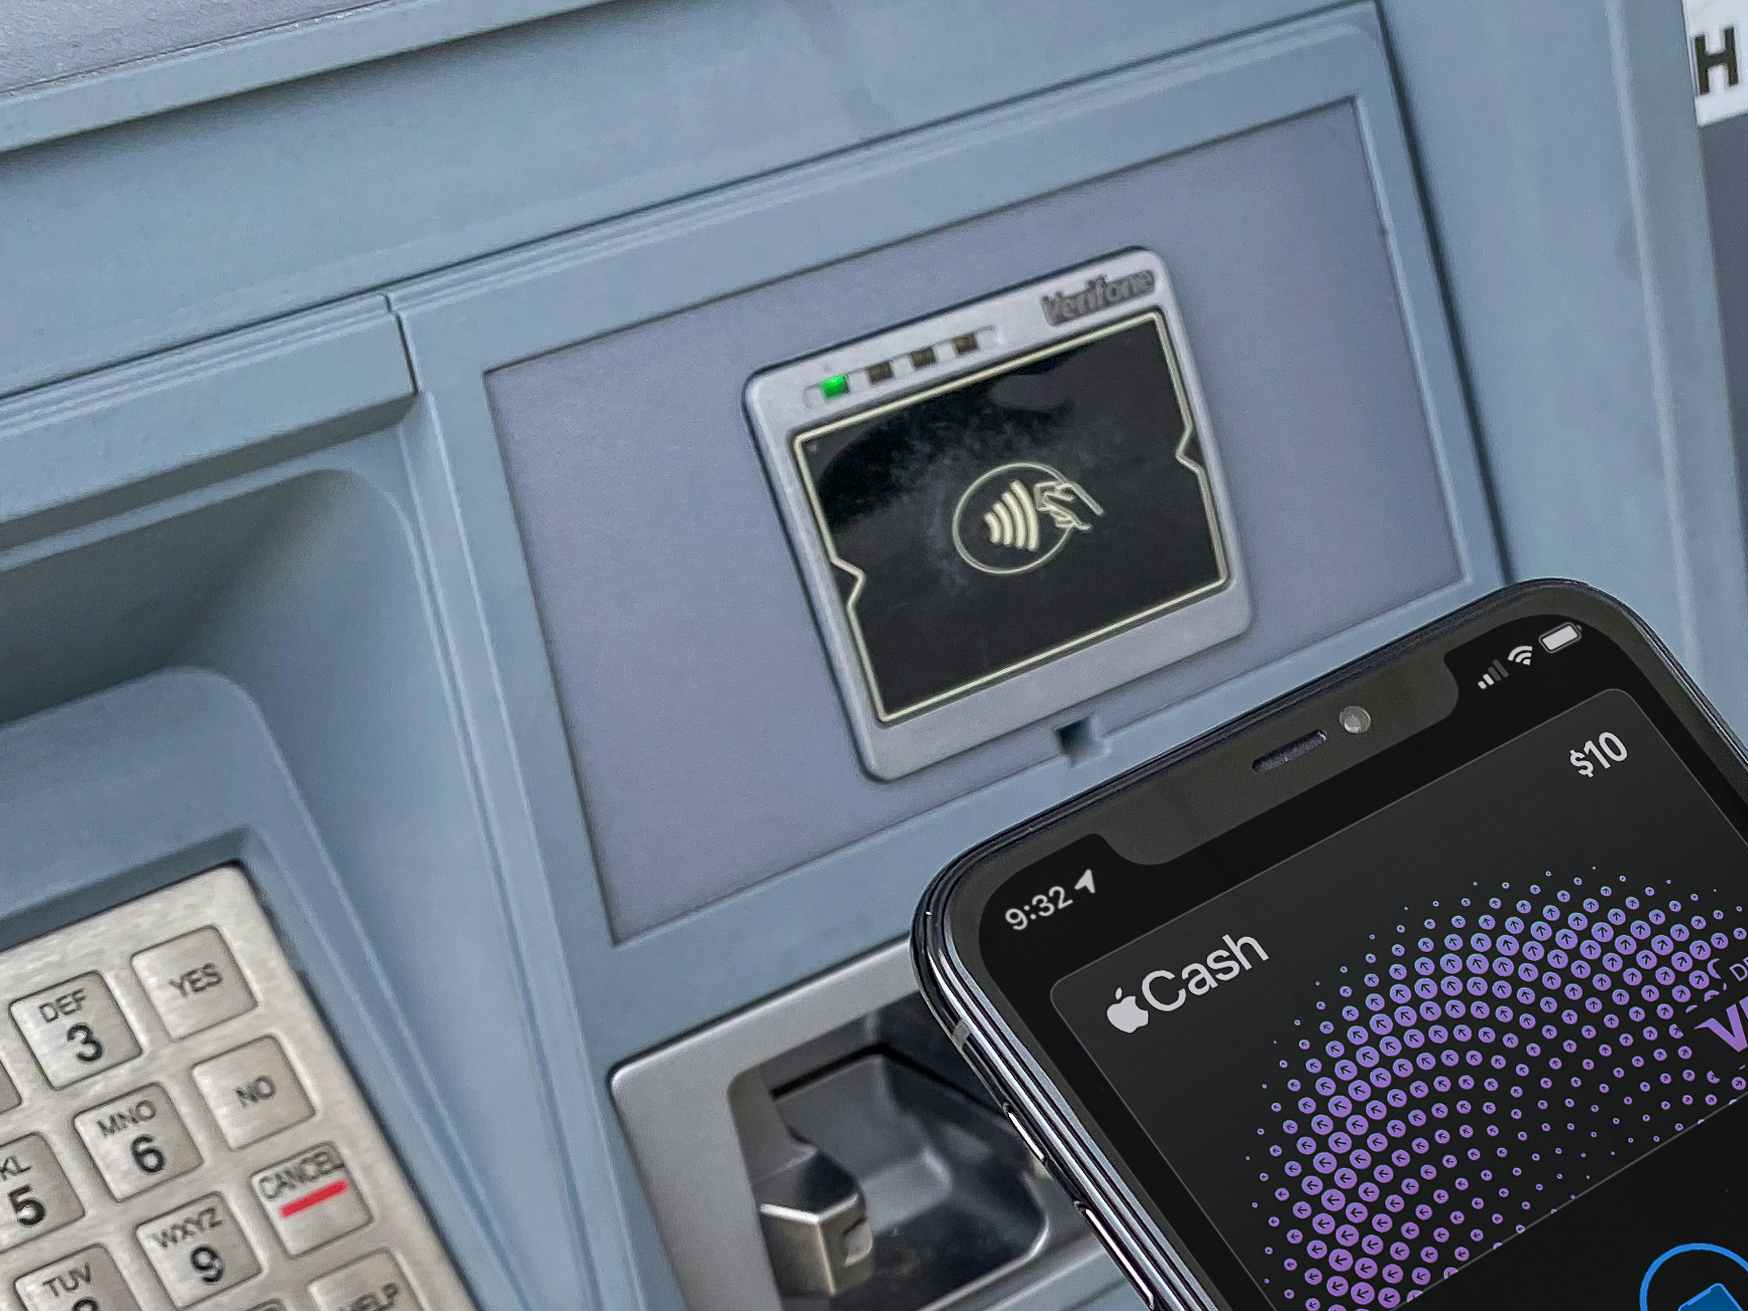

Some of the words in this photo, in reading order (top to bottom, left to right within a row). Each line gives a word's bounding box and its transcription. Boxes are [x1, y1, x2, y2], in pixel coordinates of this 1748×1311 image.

[1569, 731, 1628, 778] $10
[1004, 886, 1073, 930] 9:32
[168, 963, 224, 998] YES
[1141, 934, 1270, 1012] Cash
[38, 988, 87, 1023] DEF
[66, 1022, 103, 1062] 3
[234, 1074, 276, 1108] NO
[96, 1099, 156, 1137] MNO
[0, 1155, 32, 1182] KL
[130, 1134, 165, 1174] 6
[257, 1151, 346, 1201] CANCEL
[8, 1184, 46, 1227] 5
[152, 1206, 224, 1249] WXYZ
[42, 1262, 92, 1298] TUV
[190, 1245, 225, 1284] 9
